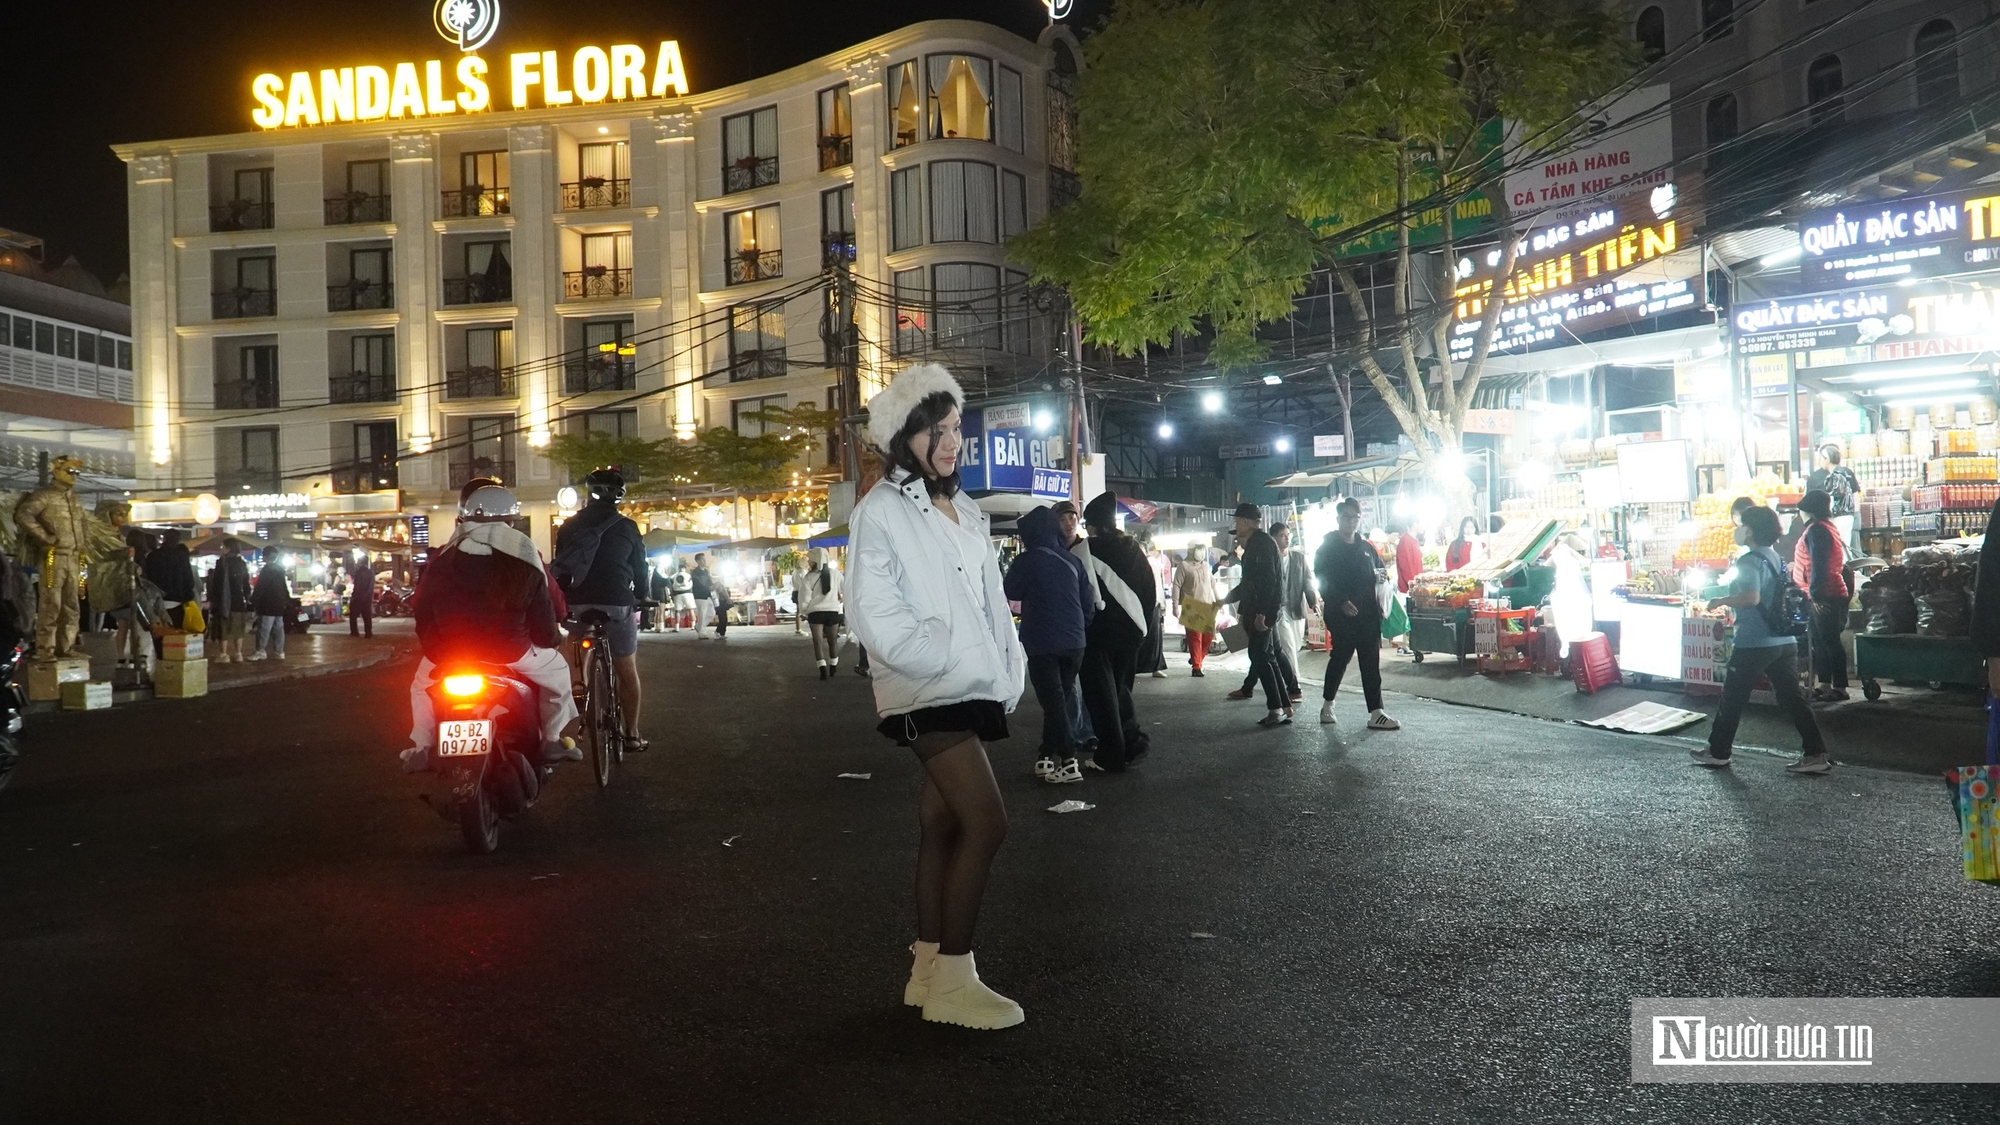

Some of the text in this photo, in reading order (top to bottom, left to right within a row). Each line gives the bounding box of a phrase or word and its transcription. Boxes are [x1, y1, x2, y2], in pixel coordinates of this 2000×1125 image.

[252, 40, 689, 129] SANDALS FLORA
[1545, 151, 1631, 179] NHÀ HÀNG
[1513, 187, 1536, 206] CÁ
[1540, 182, 1576, 200] TẦM
[1581, 177, 1614, 195] KHE
[1456, 198, 1492, 220] NAM
[1533, 226, 1570, 251] ĐẶC
[1575, 210, 1614, 236] SẢN
[1803, 211, 1860, 255] QUẦY
[1865, 210, 1909, 247] ĐẶC
[1913, 200, 1957, 236] SẢN
[1737, 300, 1795, 333] QUẦY
[1796, 297, 1841, 326] ĐẶC
[1842, 291, 1888, 318] SẢN
[1798, 331, 1817, 340] MINH
[1818, 329, 1837, 337] KHAI
[960, 437, 980, 467] XE
[994, 432, 1025, 467] BÃI
[1033, 473, 1070, 494] BÃI GIỮ XE
[1683, 643, 1699, 658] XOÀI
[1684, 666, 1700, 680] KEM
[1701, 667, 1712, 681] BƠ
[447, 722, 483, 738] 49-B2
[441, 738, 488, 755] 097.28
